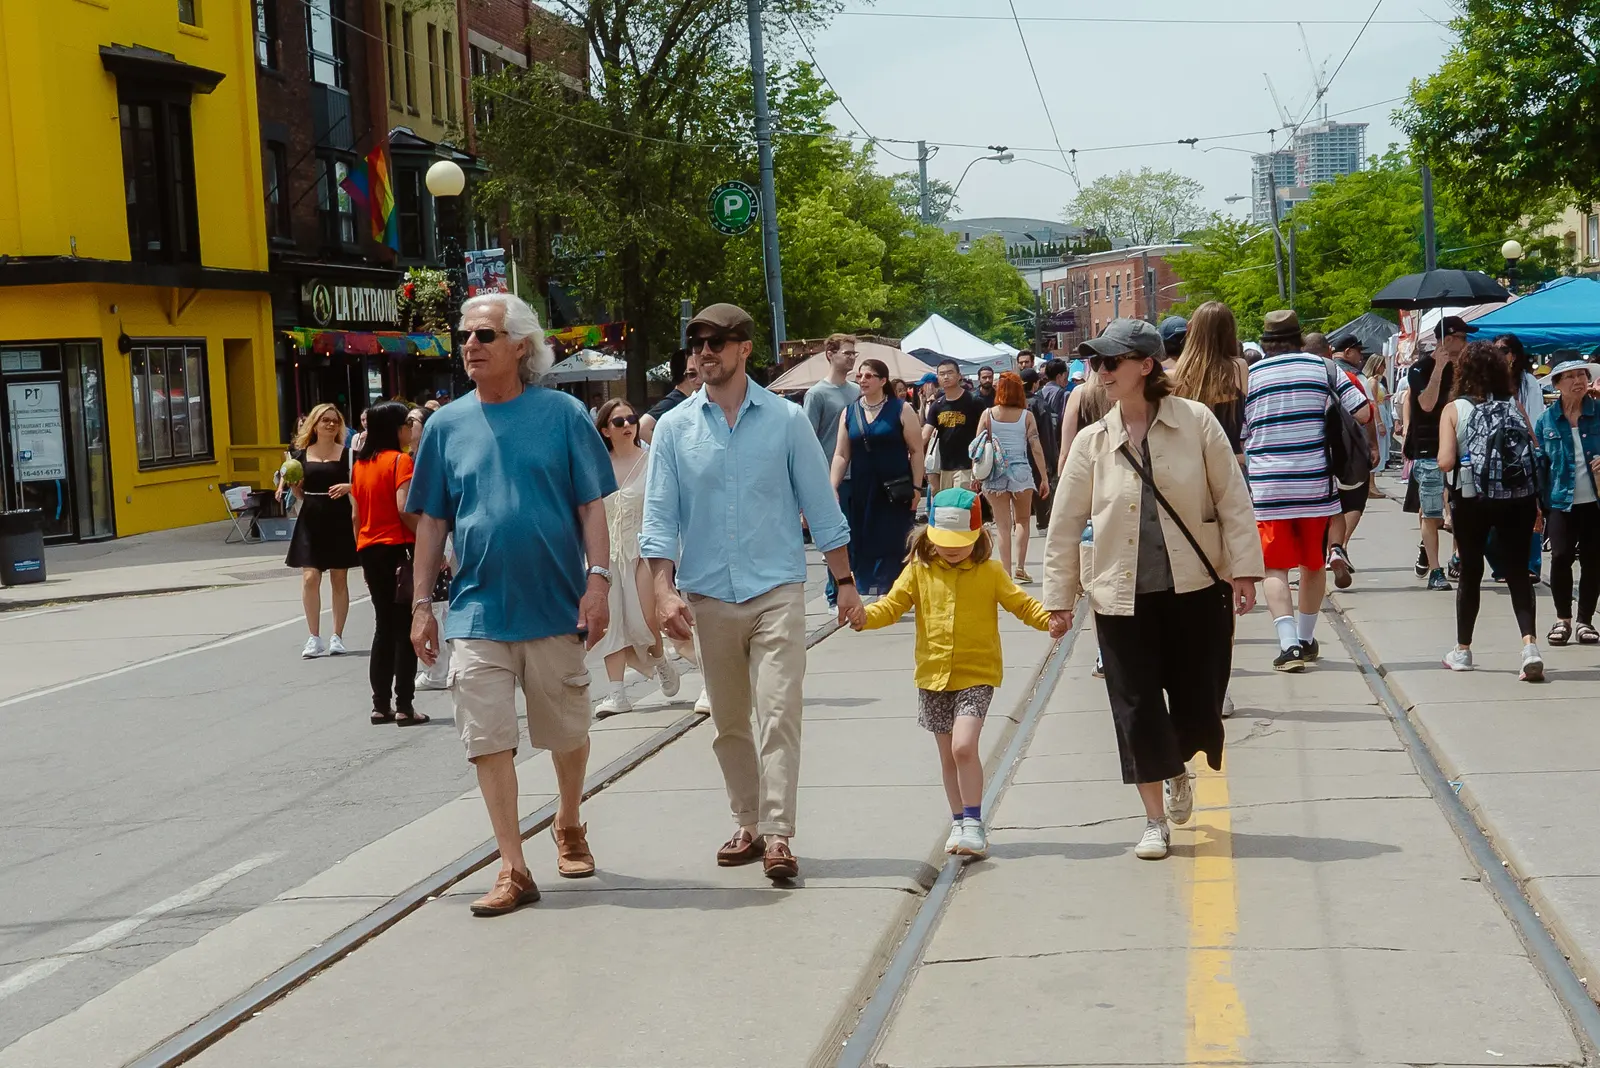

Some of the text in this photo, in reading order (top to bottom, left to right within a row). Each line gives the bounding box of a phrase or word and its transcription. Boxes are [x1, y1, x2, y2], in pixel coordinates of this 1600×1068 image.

[724, 195, 743, 217] P
[475, 286, 499, 296] SHOP
[334, 285, 399, 322] LA PATRONA
[24, 388, 40, 400] PT
